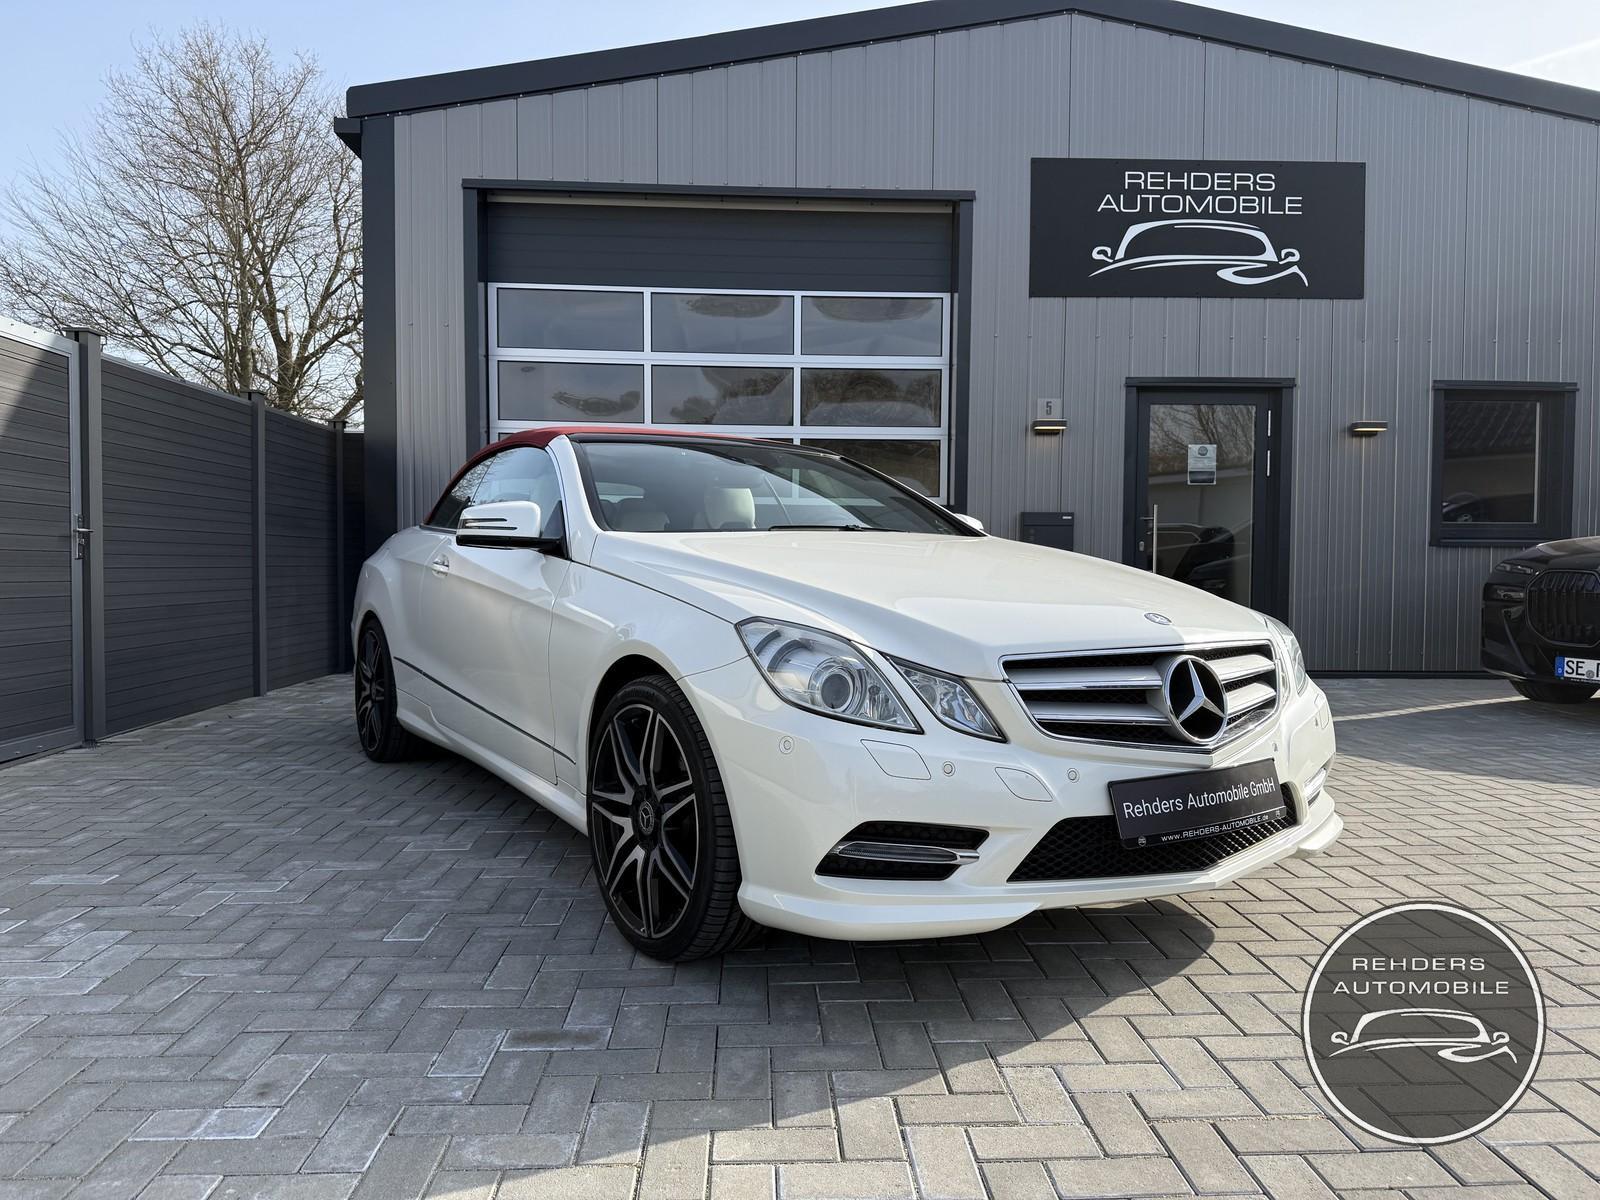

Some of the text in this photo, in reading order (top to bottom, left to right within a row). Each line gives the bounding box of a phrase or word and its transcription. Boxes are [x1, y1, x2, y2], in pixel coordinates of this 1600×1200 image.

[1124, 171, 1276, 192] REHDERS
[1097, 194, 1303, 215] AUTOMOBILE
[1045, 401, 1052, 415] 5
[1565, 660, 1585, 676] SE
[1123, 777, 1276, 819] Rehders Automobile GmbH
[1161, 814, 1269, 842] www.REHDERS-AUTOMOBILE.de
